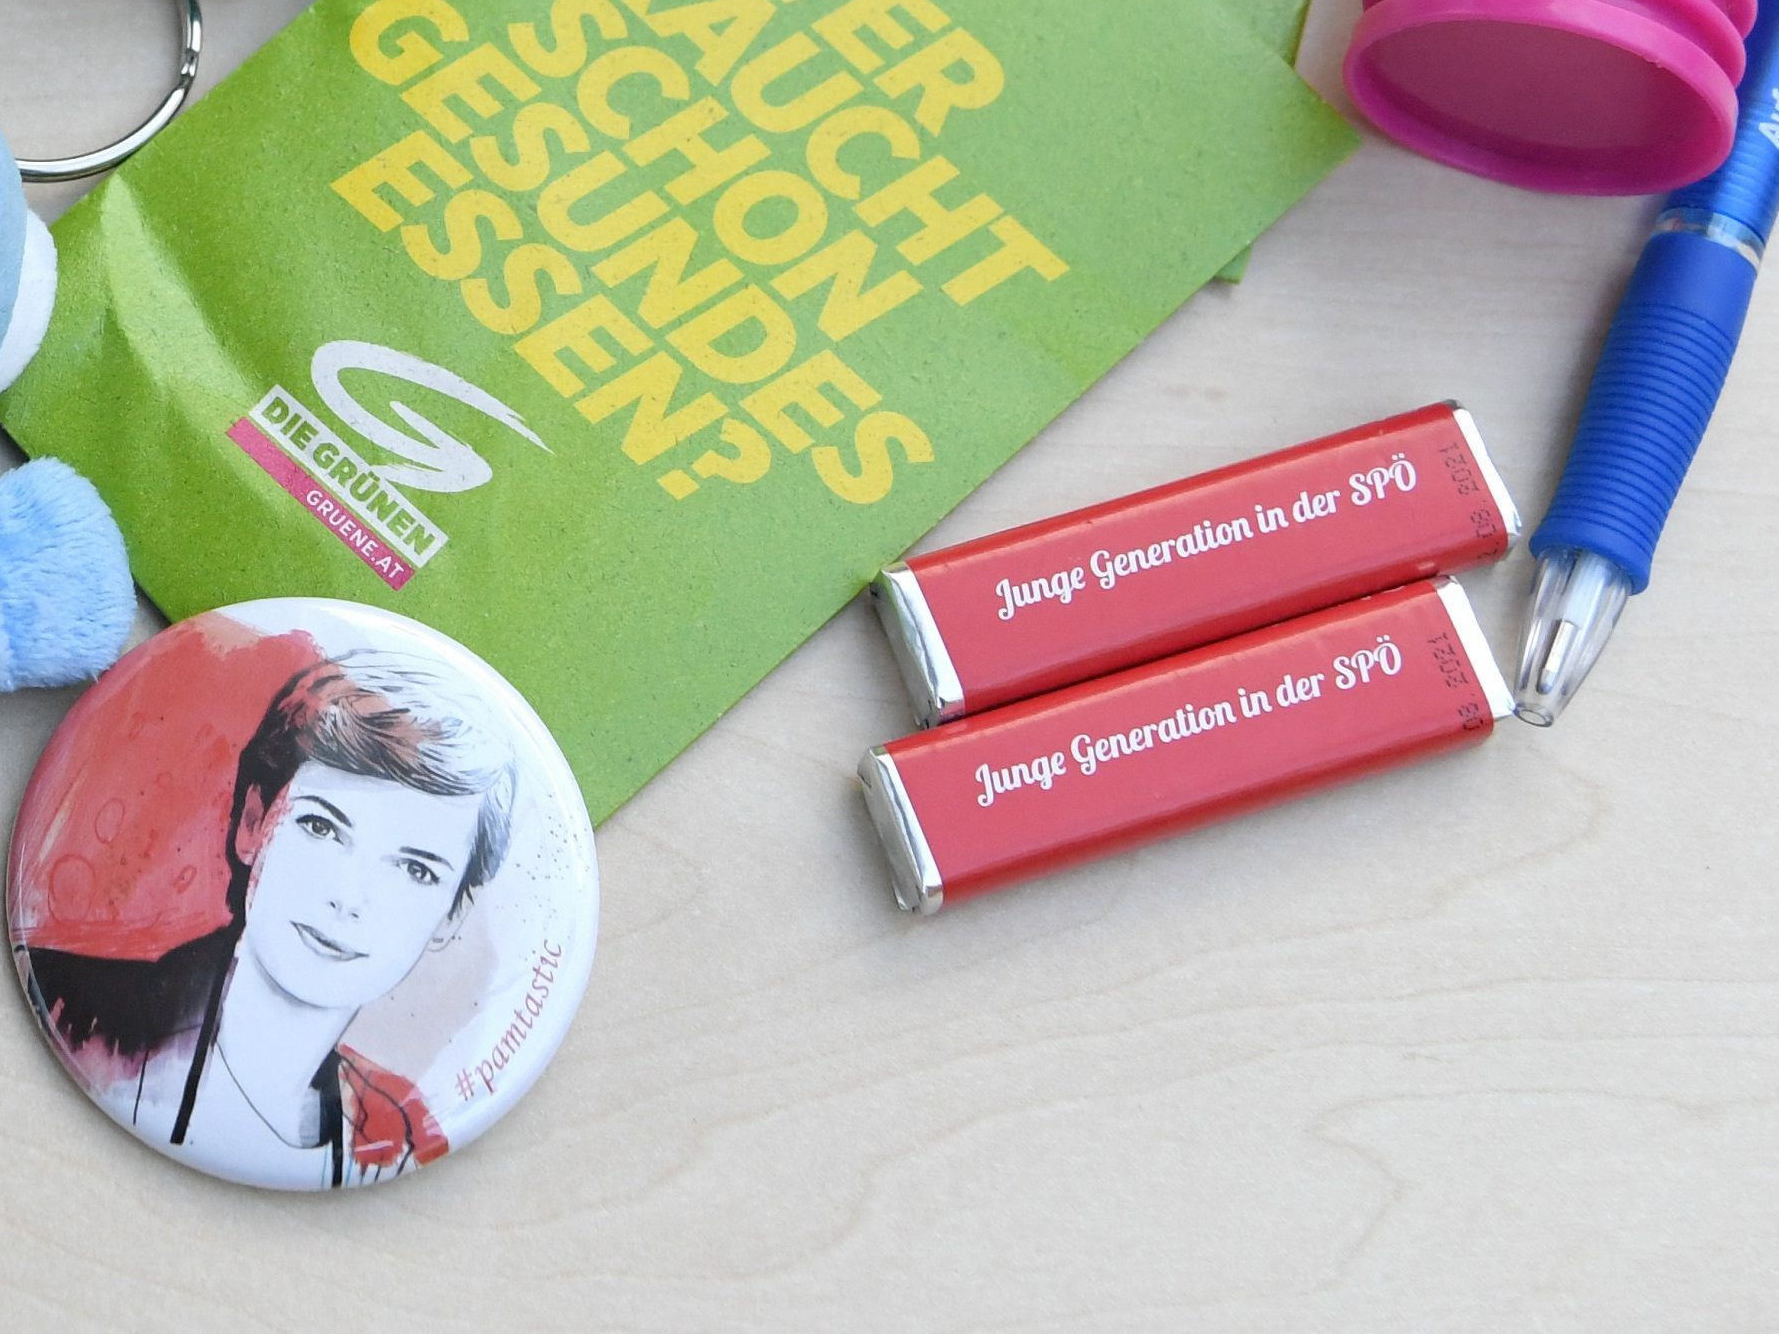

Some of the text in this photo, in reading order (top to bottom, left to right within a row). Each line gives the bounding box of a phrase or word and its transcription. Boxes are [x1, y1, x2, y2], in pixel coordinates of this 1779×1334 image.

[330, 129, 772, 501] ESSEN?
[261, 396, 436, 557] DIE GRÜNEN
[306, 490, 405, 579] GRUENE.AT
[995, 452, 1417, 621] Junge Generation in der SPÖ
[974, 635, 1403, 807] Junge Generation in der SPÖ
[454, 939, 562, 1102] #pamtastic
